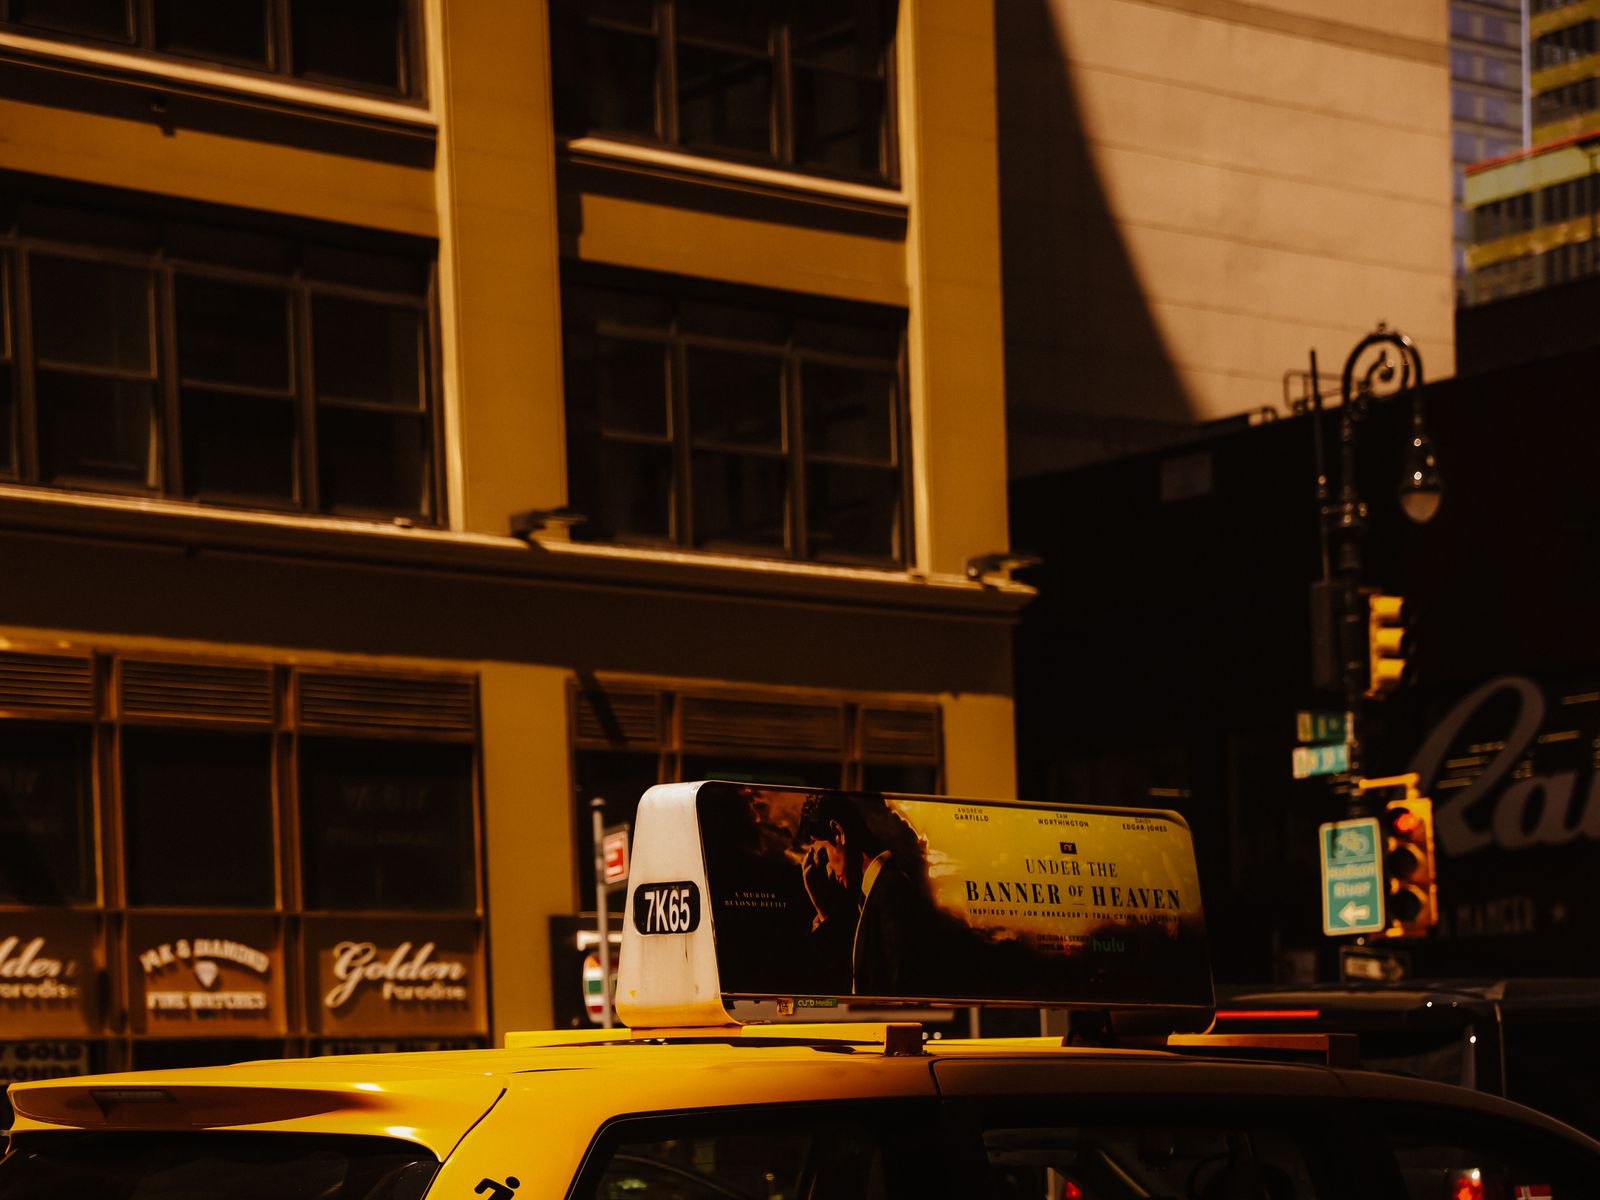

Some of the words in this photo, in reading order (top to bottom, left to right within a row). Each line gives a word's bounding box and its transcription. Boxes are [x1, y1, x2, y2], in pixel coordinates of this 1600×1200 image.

[954, 813, 989, 823] GARFIELD
[1037, 818, 1090, 828] WORTHINGTON
[1122, 823, 1168, 833] EDGAR-JONES
[1025, 858, 1081, 876] UNDER
[1086, 861, 1119, 878] THE
[965, 880, 1062, 905] BANNER
[1068, 885, 1084, 897] OF
[1090, 887, 1182, 910] HEAVEN
[644, 889, 690, 933] 7K65
[969, 908, 1006, 917] INSPIRED
[1009, 909, 1019, 917] BY
[1037, 934, 1066, 943] ORIGINAL
[1092, 936, 1126, 953] hulu
[324, 941, 466, 1008] Golden
